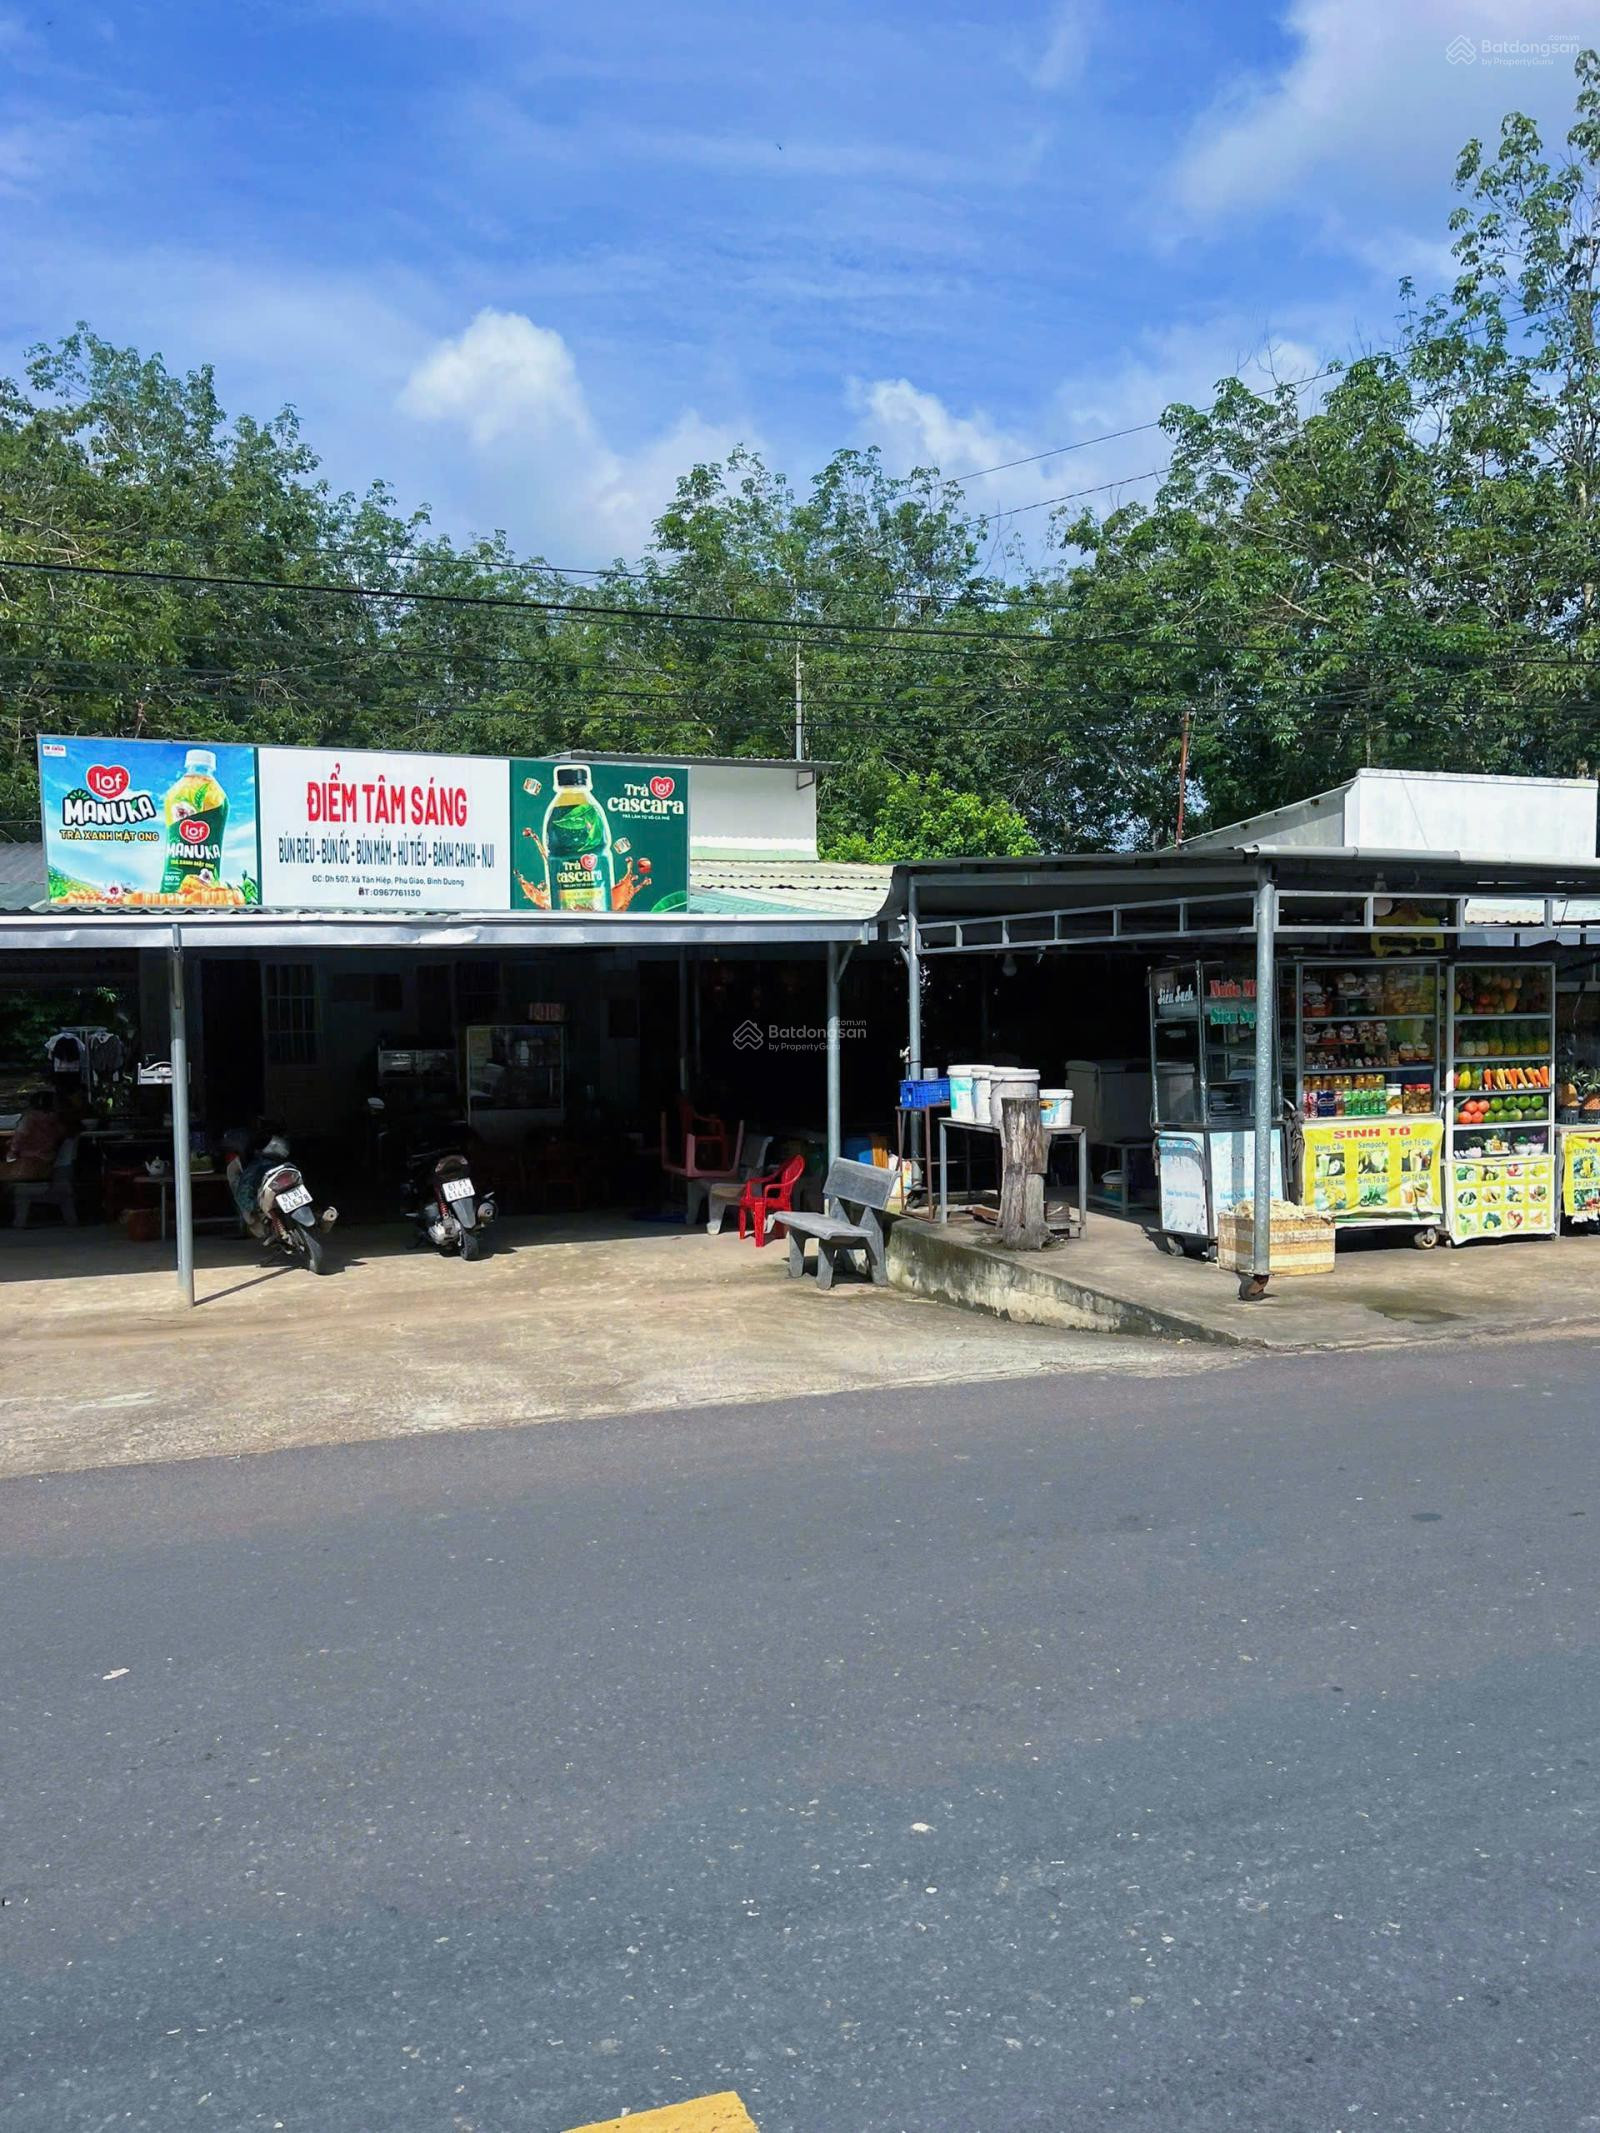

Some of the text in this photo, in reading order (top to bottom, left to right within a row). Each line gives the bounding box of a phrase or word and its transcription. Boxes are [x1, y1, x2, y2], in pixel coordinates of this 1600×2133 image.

[96, 772, 122, 789] lof
[307, 763, 468, 827] ĐIỂM TÂM SÁNG
[624, 783, 650, 797] Trà
[63, 795, 156, 826] MANUKA
[607, 796, 685, 815] cascara
[59, 828, 159, 844] TRÀ XANH MẬT ONG
[278, 830, 296, 864] BÚN
[297, 831, 315, 864] RIÊU
[321, 831, 338, 865] BÚN
[339, 829, 350, 865] ỐC
[356, 833, 373, 865] BÚN
[433, 835, 454, 868] BÁNH
[455, 842, 476, 868] CANH
[1333, 1128, 1381, 1139] SINH
